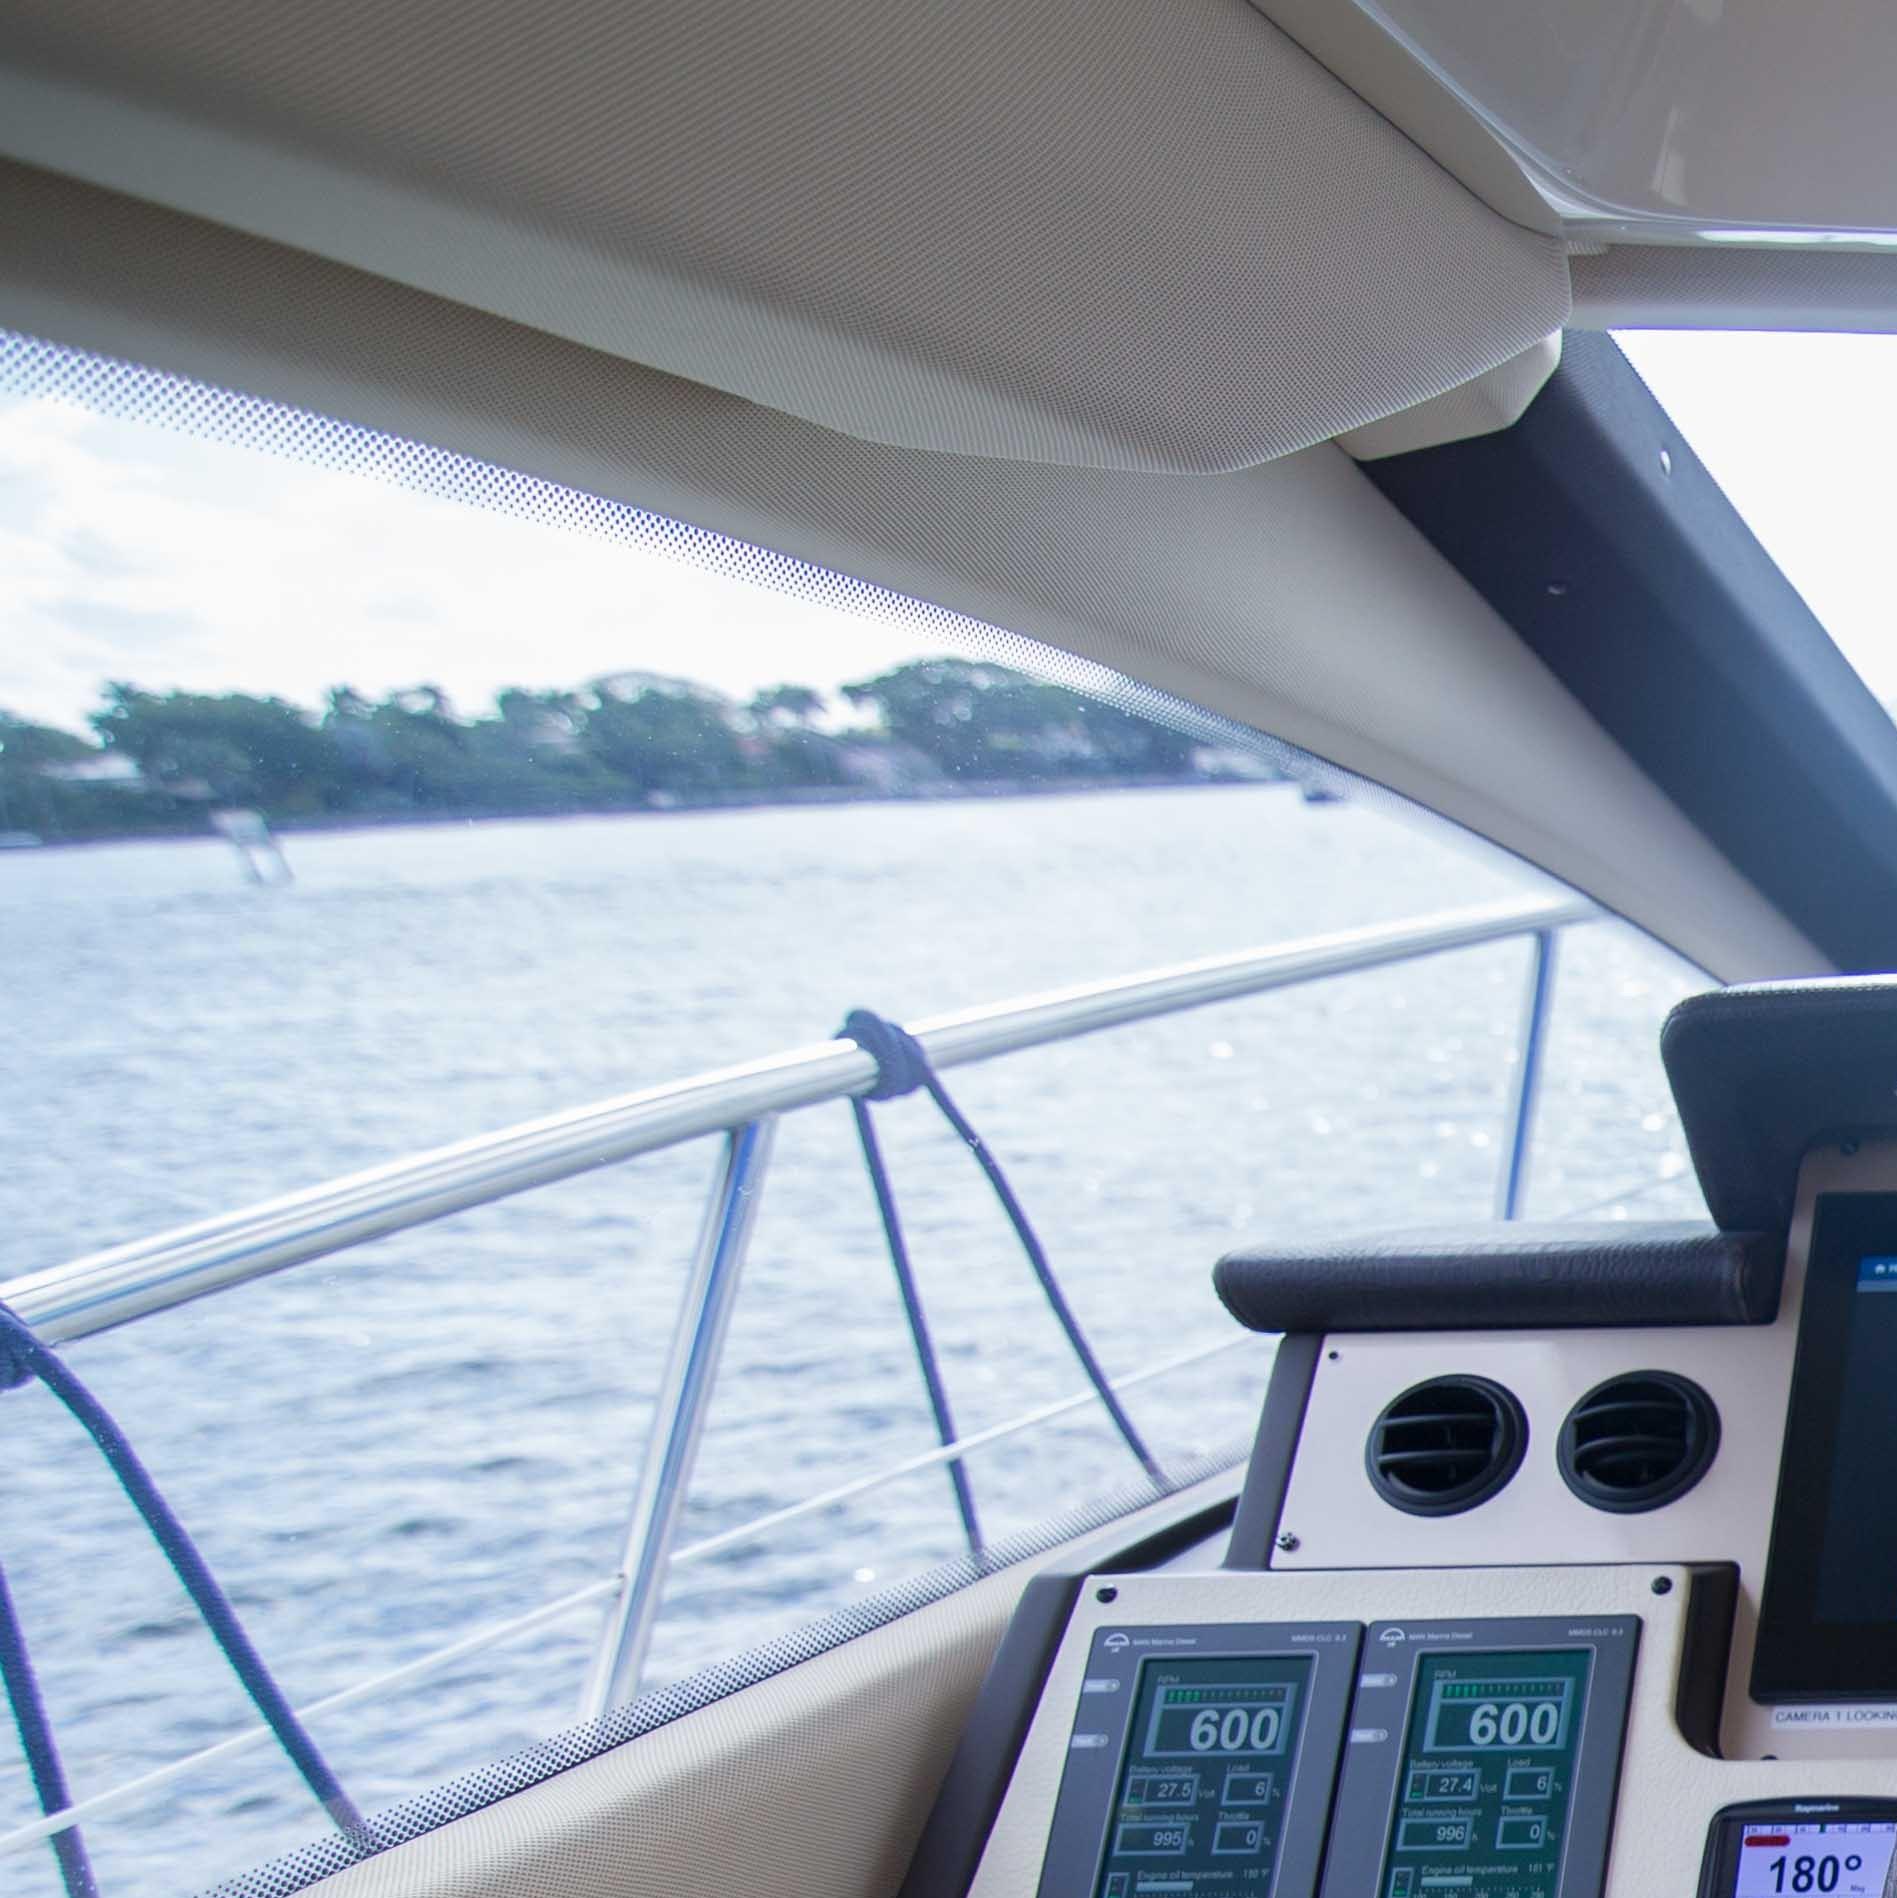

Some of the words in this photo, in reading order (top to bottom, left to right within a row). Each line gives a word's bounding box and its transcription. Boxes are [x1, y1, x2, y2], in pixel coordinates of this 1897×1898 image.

[1776, 1711, 1830, 1721] CAMERA
[1190, 1708, 1279, 1751] 600
[1469, 1703, 1559, 1746] 600
[1157, 1783, 1192, 1798] 27.5
[1255, 1781, 1265, 1796] 6
[1439, 1777, 1472, 1793] 27.4
[1536, 1776, 1547, 1791] 6
[1153, 1831, 1182, 1847] 995
[1246, 1829, 1257, 1845] 0
[1436, 1826, 1465, 1841] 996
[1529, 1824, 1541, 1839] 0
[1770, 1855, 1862, 1893] 180°
